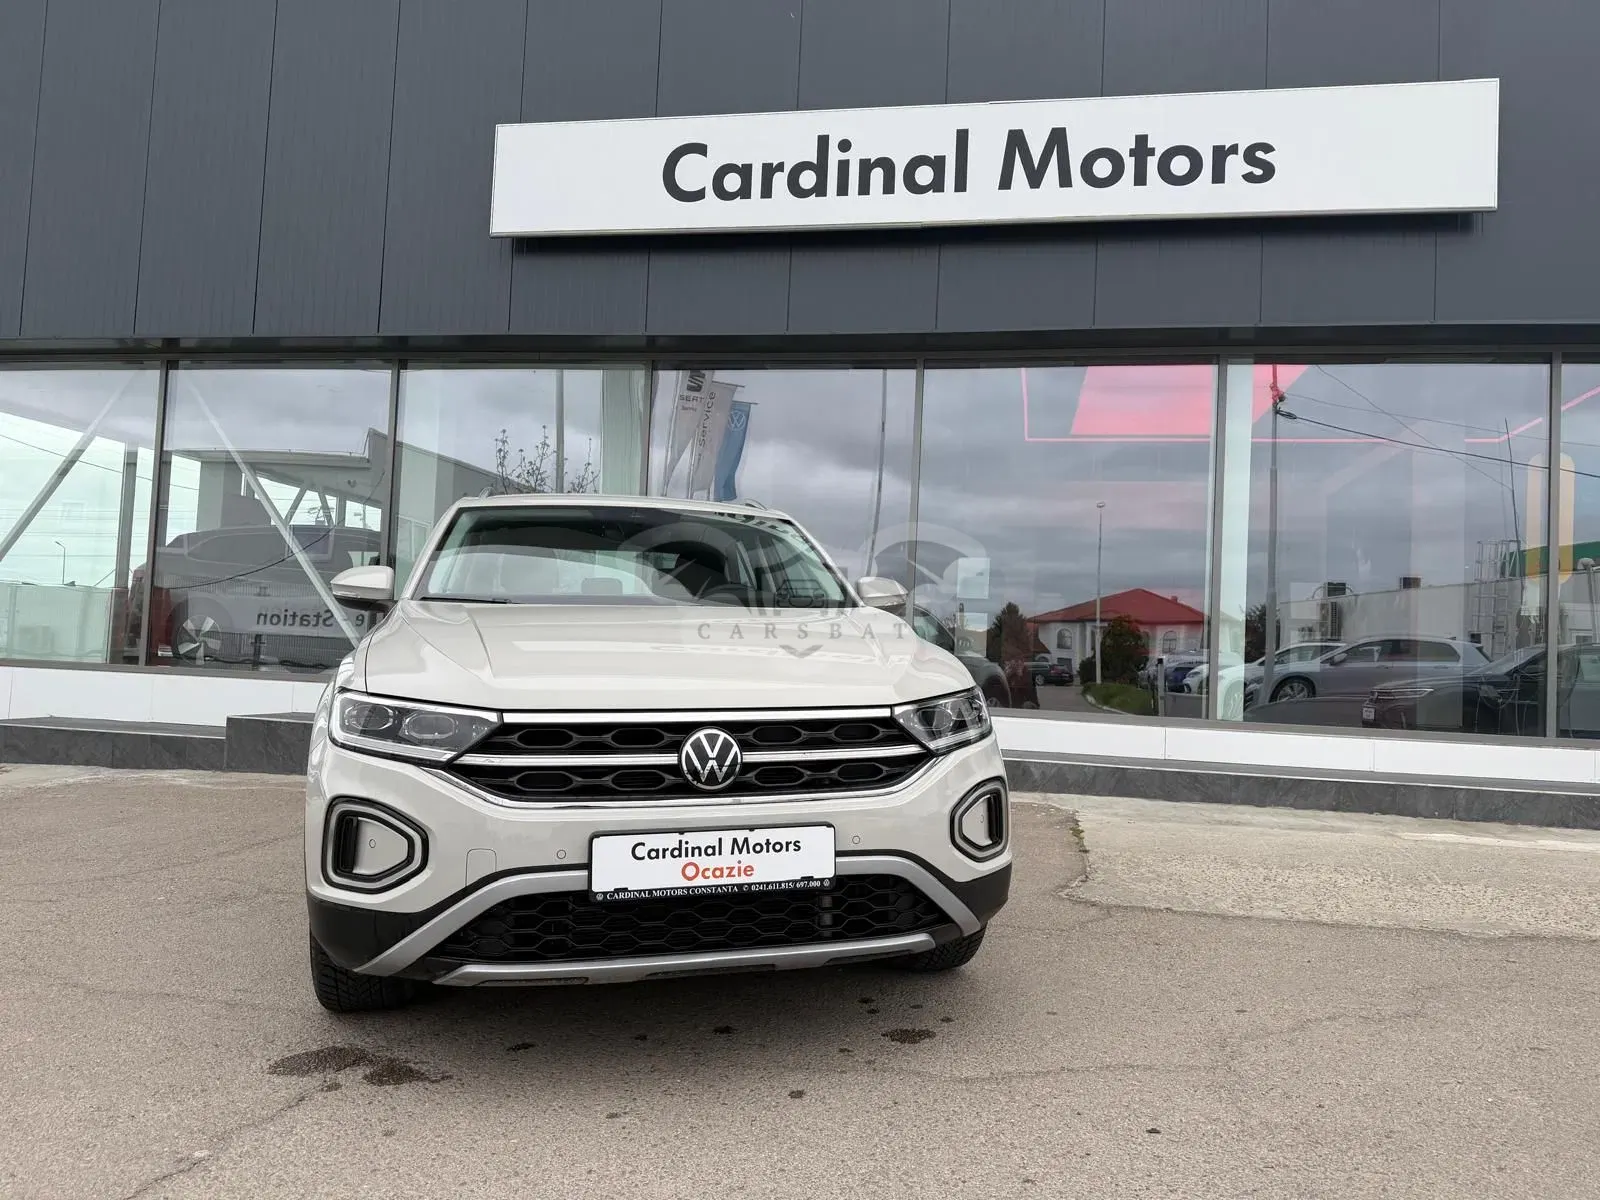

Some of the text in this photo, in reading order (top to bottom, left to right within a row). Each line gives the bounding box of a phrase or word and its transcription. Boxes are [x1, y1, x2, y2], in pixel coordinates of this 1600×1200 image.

[662, 127, 1276, 203] Cardinal Motors
[631, 836, 802, 861] Cardinal Motors
[681, 860, 755, 882] Ocazie
[606, 890, 651, 900] CARDINAL
[652, 887, 688, 898] MOTORS
[689, 885, 739, 895] CONSTANTA
